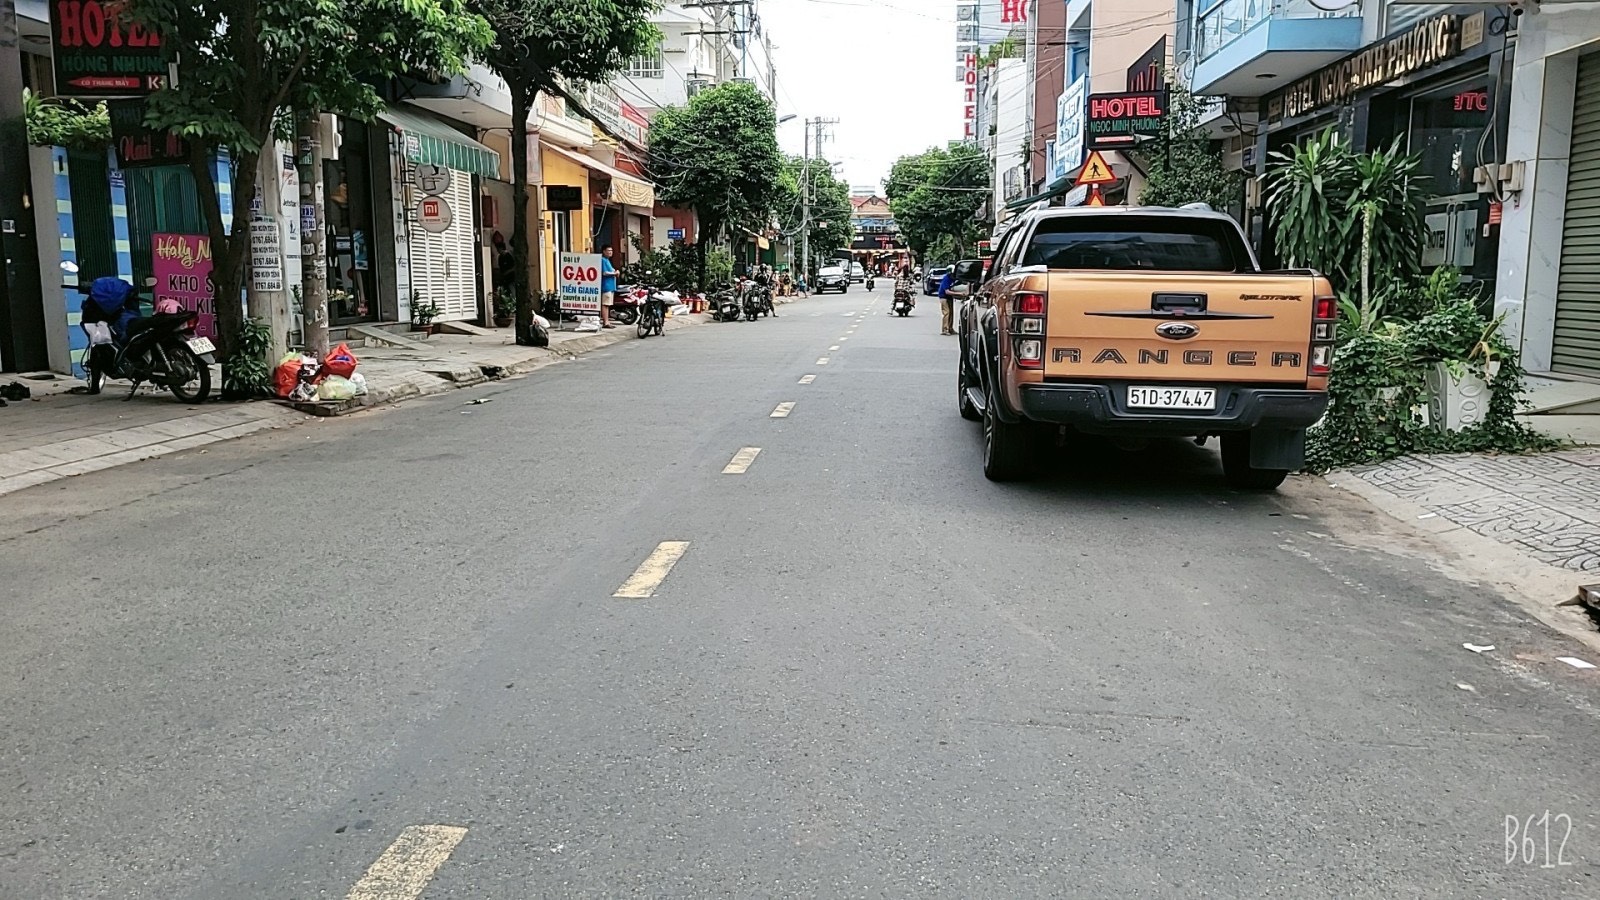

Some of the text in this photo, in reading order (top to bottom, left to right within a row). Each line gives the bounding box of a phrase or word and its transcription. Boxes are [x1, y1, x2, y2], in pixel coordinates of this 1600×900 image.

[965, 53, 977, 136] HOTEL
[1283, 78, 1315, 118] HOTEL
[1092, 97, 1161, 118] HOTEL
[1090, 120, 1111, 133] NGỌC
[1112, 119, 1130, 131] MINH
[169, 274, 199, 293] KHO
[563, 265, 598, 285] GẠO
[578, 286, 599, 295] GIANG
[1169, 326, 1188, 334] Ford
[1052, 347, 1302, 368] RANGER
[1130, 388, 1214, 409] 51D-374.47
